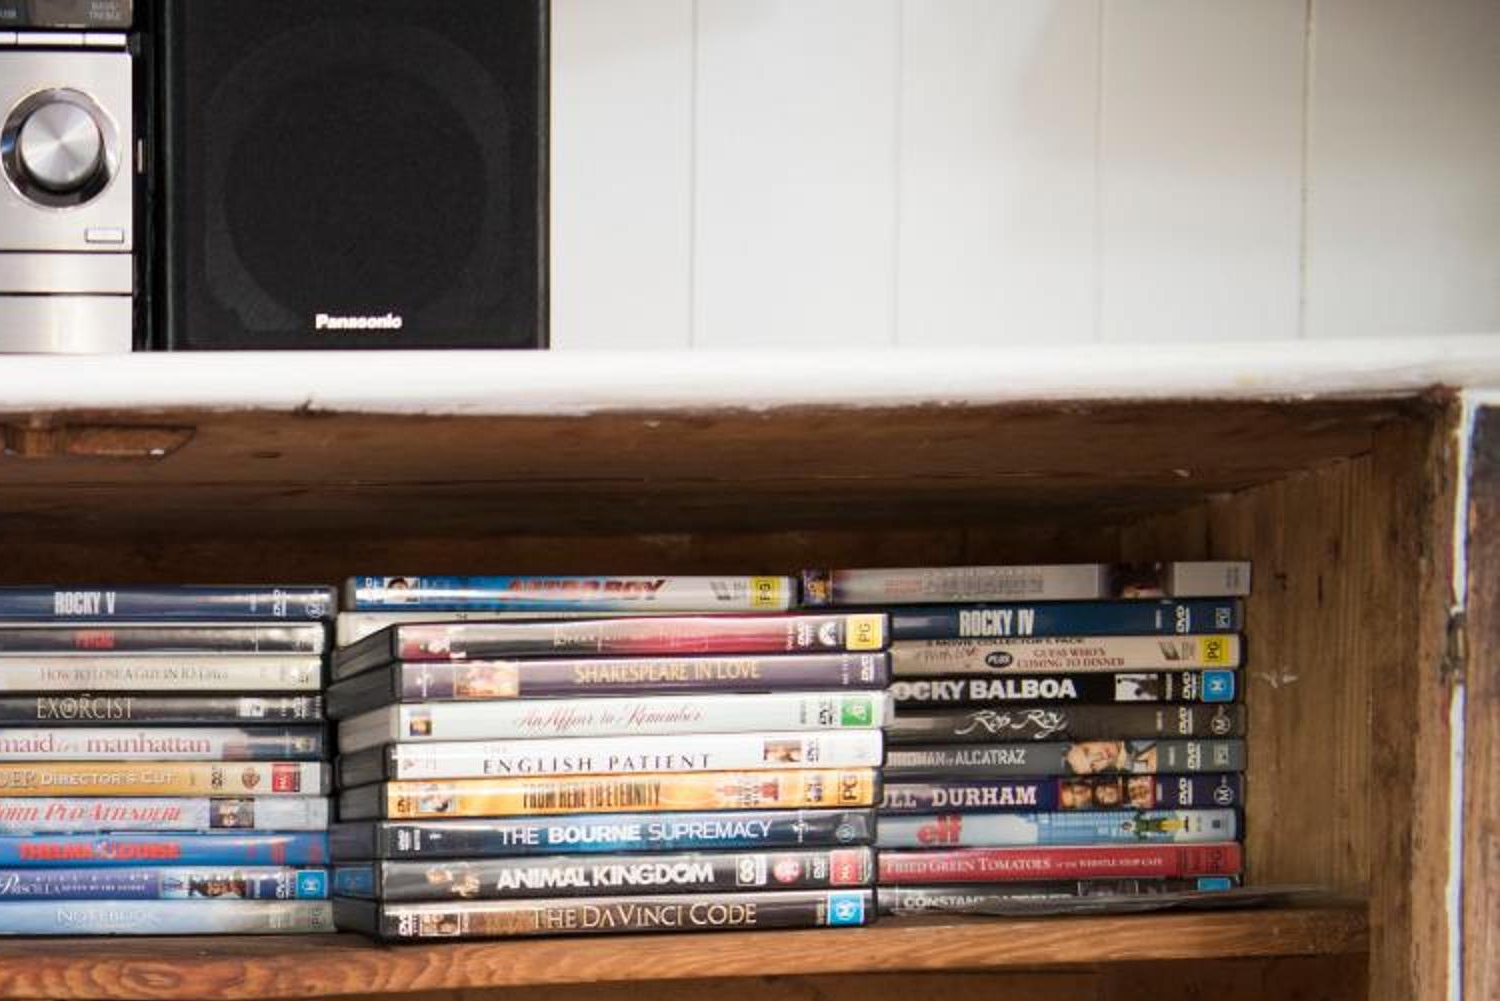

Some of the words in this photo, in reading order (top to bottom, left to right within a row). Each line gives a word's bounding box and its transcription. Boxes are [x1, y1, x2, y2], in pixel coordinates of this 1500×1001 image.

[315, 312, 403, 330] Panasonic
[54, 592, 101, 616] ROCKY
[106, 592, 117, 616] V
[958, 609, 1013, 638] ROCKY
[1017, 607, 1035, 637] IV
[572, 663, 690, 684] SHAKESPEARE
[695, 661, 713, 680] IN
[716, 660, 762, 680] LOVE
[889, 680, 965, 702] OCKY
[969, 677, 1077, 701] BALBOA
[35, 696, 133, 720] EXORCIST
[953, 709, 1012, 735] Rob
[1010, 708, 1069, 740] Roy
[86, 733, 212, 753] manhattan
[483, 757, 593, 774] ENGLISH
[607, 753, 710, 771] PATIENT
[955, 748, 1027, 766] ALCATRAZ
[606, 782, 661, 808] ETERNITY
[880, 787, 917, 809] ULL
[931, 784, 1038, 808] DURHAM
[501, 828, 541, 846] THE
[548, 824, 642, 845] BOURNE
[646, 818, 773, 842] SUPREMACY
[496, 867, 590, 891] ANIMAL
[593, 862, 716, 887] KINGDOM
[885, 860, 928, 875] FRIED
[929, 858, 975, 873] GREEN
[977, 855, 1051, 872] TOMATOES
[534, 907, 579, 930] THE
[615, 904, 684, 928] VINCI
[689, 901, 758, 927] CODE
